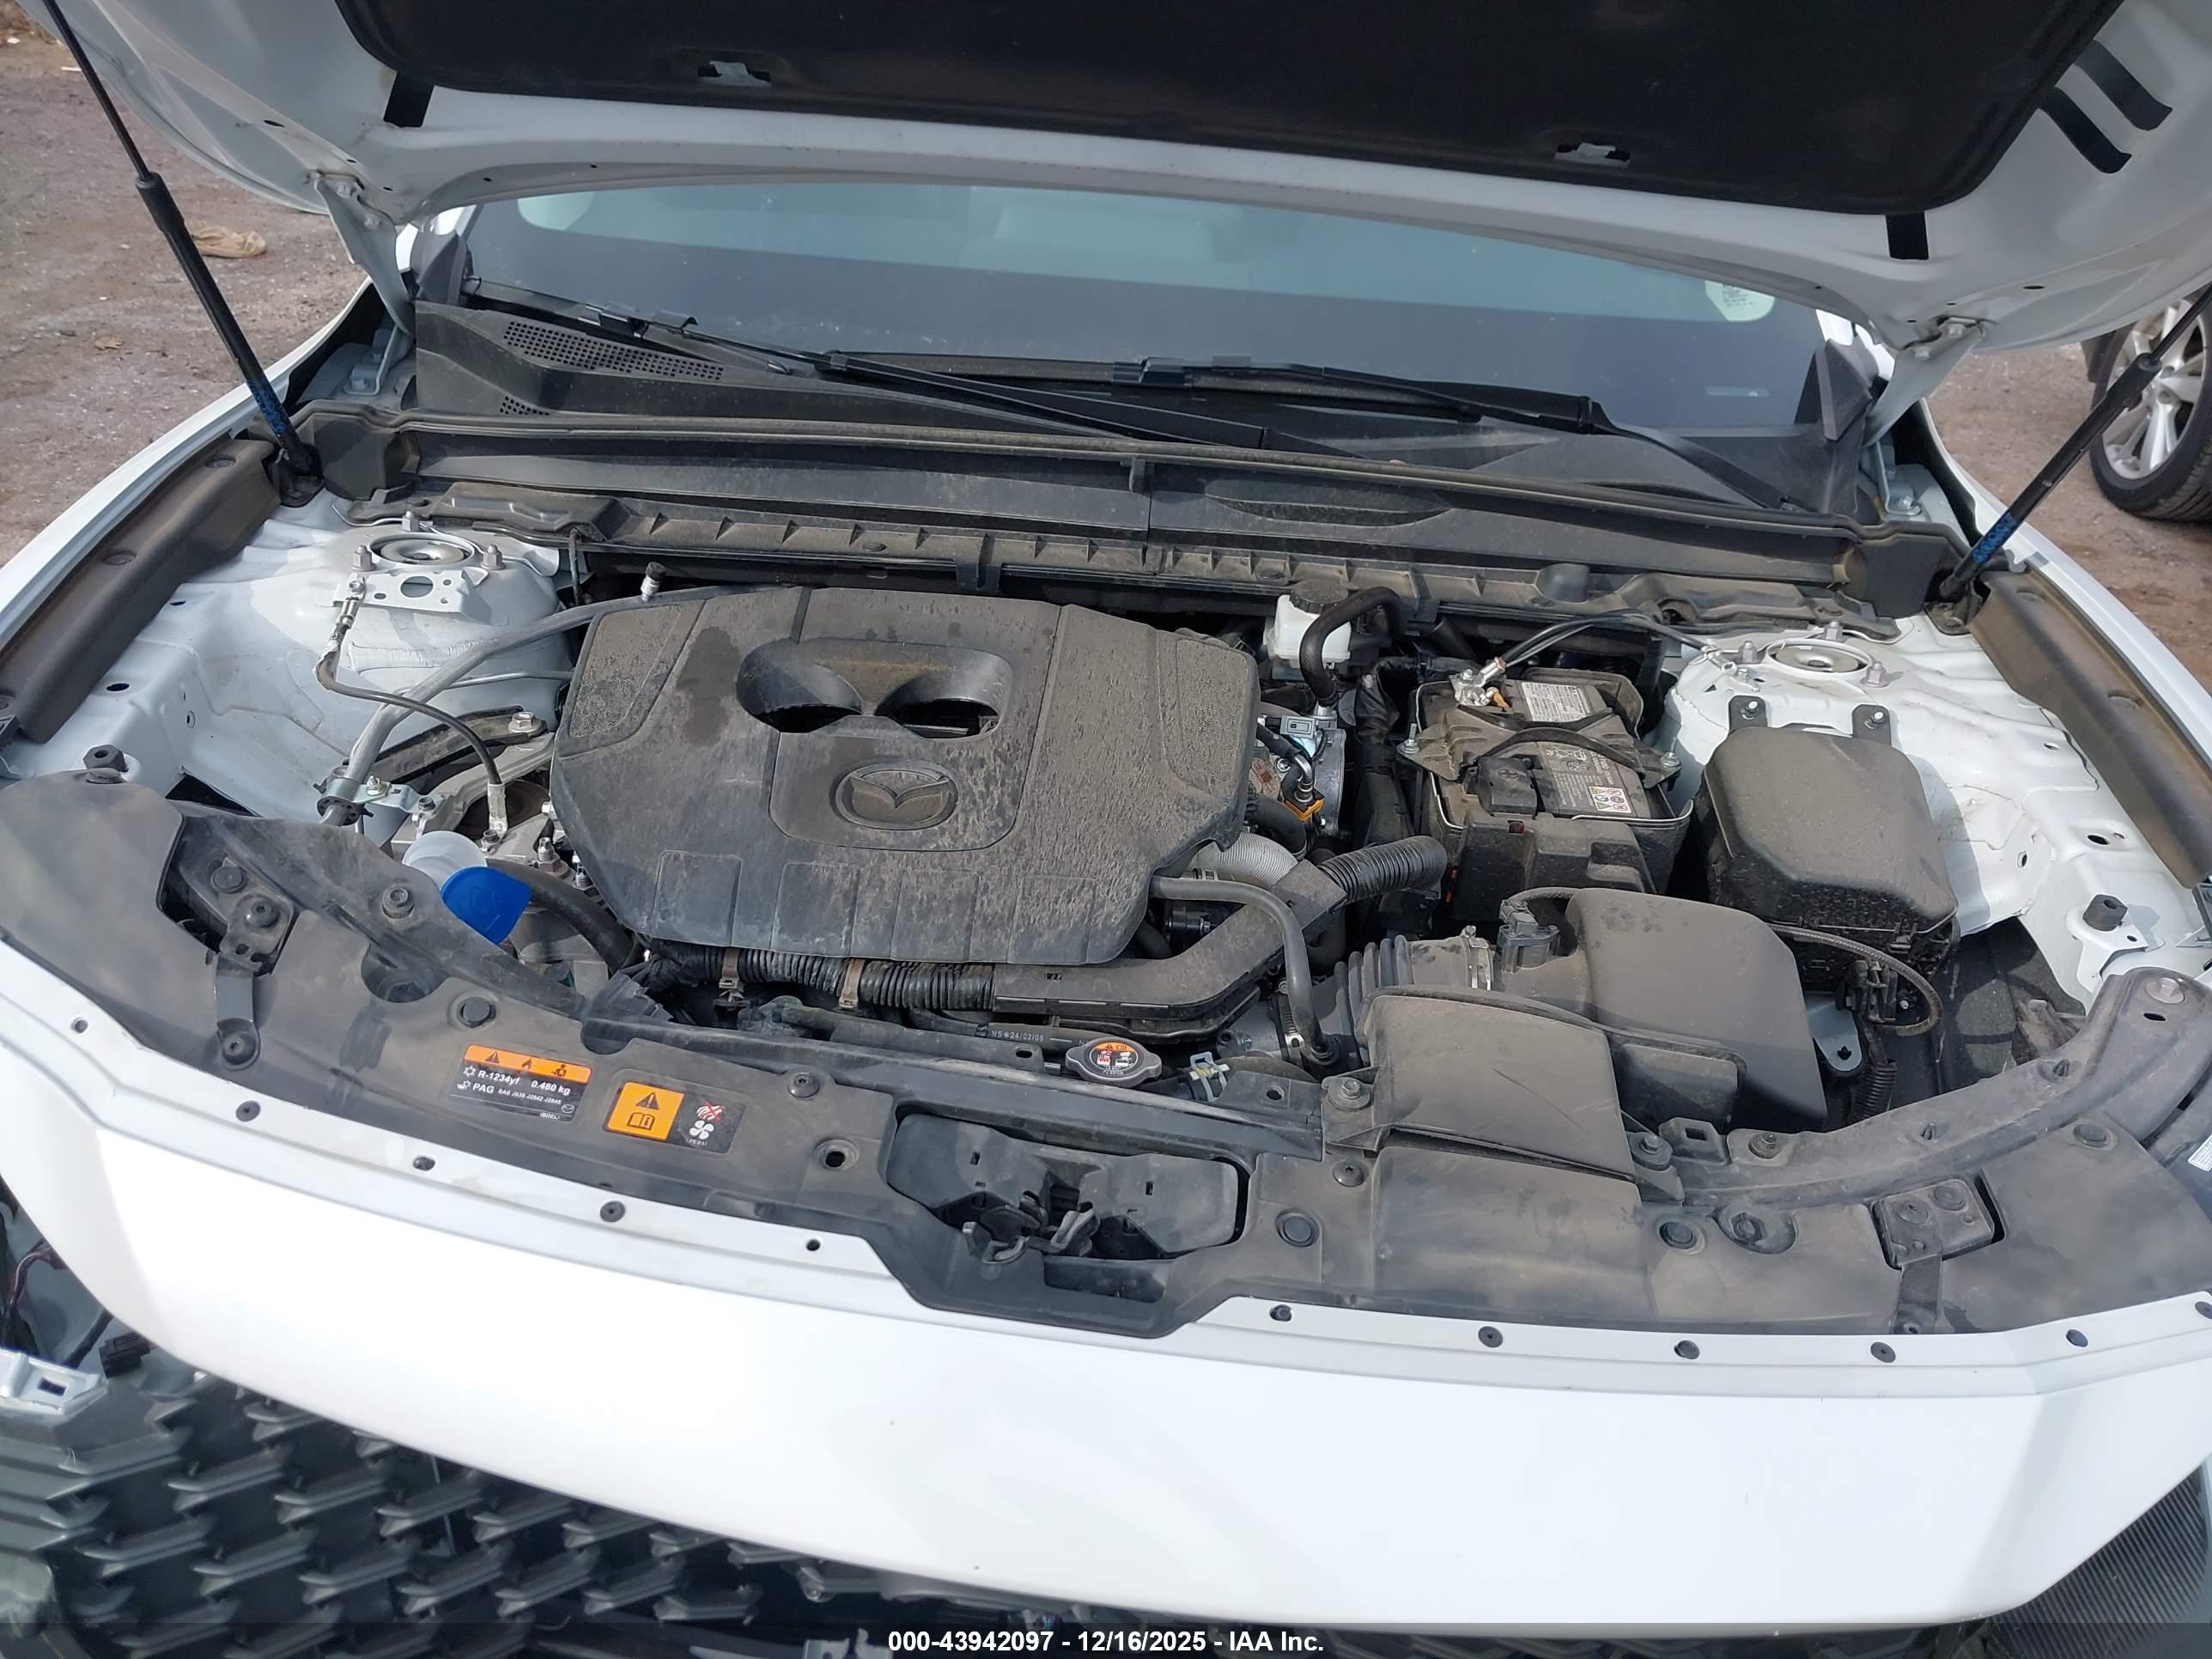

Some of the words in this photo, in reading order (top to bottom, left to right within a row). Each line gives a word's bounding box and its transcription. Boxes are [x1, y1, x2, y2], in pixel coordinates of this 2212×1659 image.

[472, 1082, 495, 1094] PAG
[477, 1069, 520, 1085] R-1234yf
[531, 1080, 556, 1092] 0.480
[557, 1085, 571, 1096] kg
